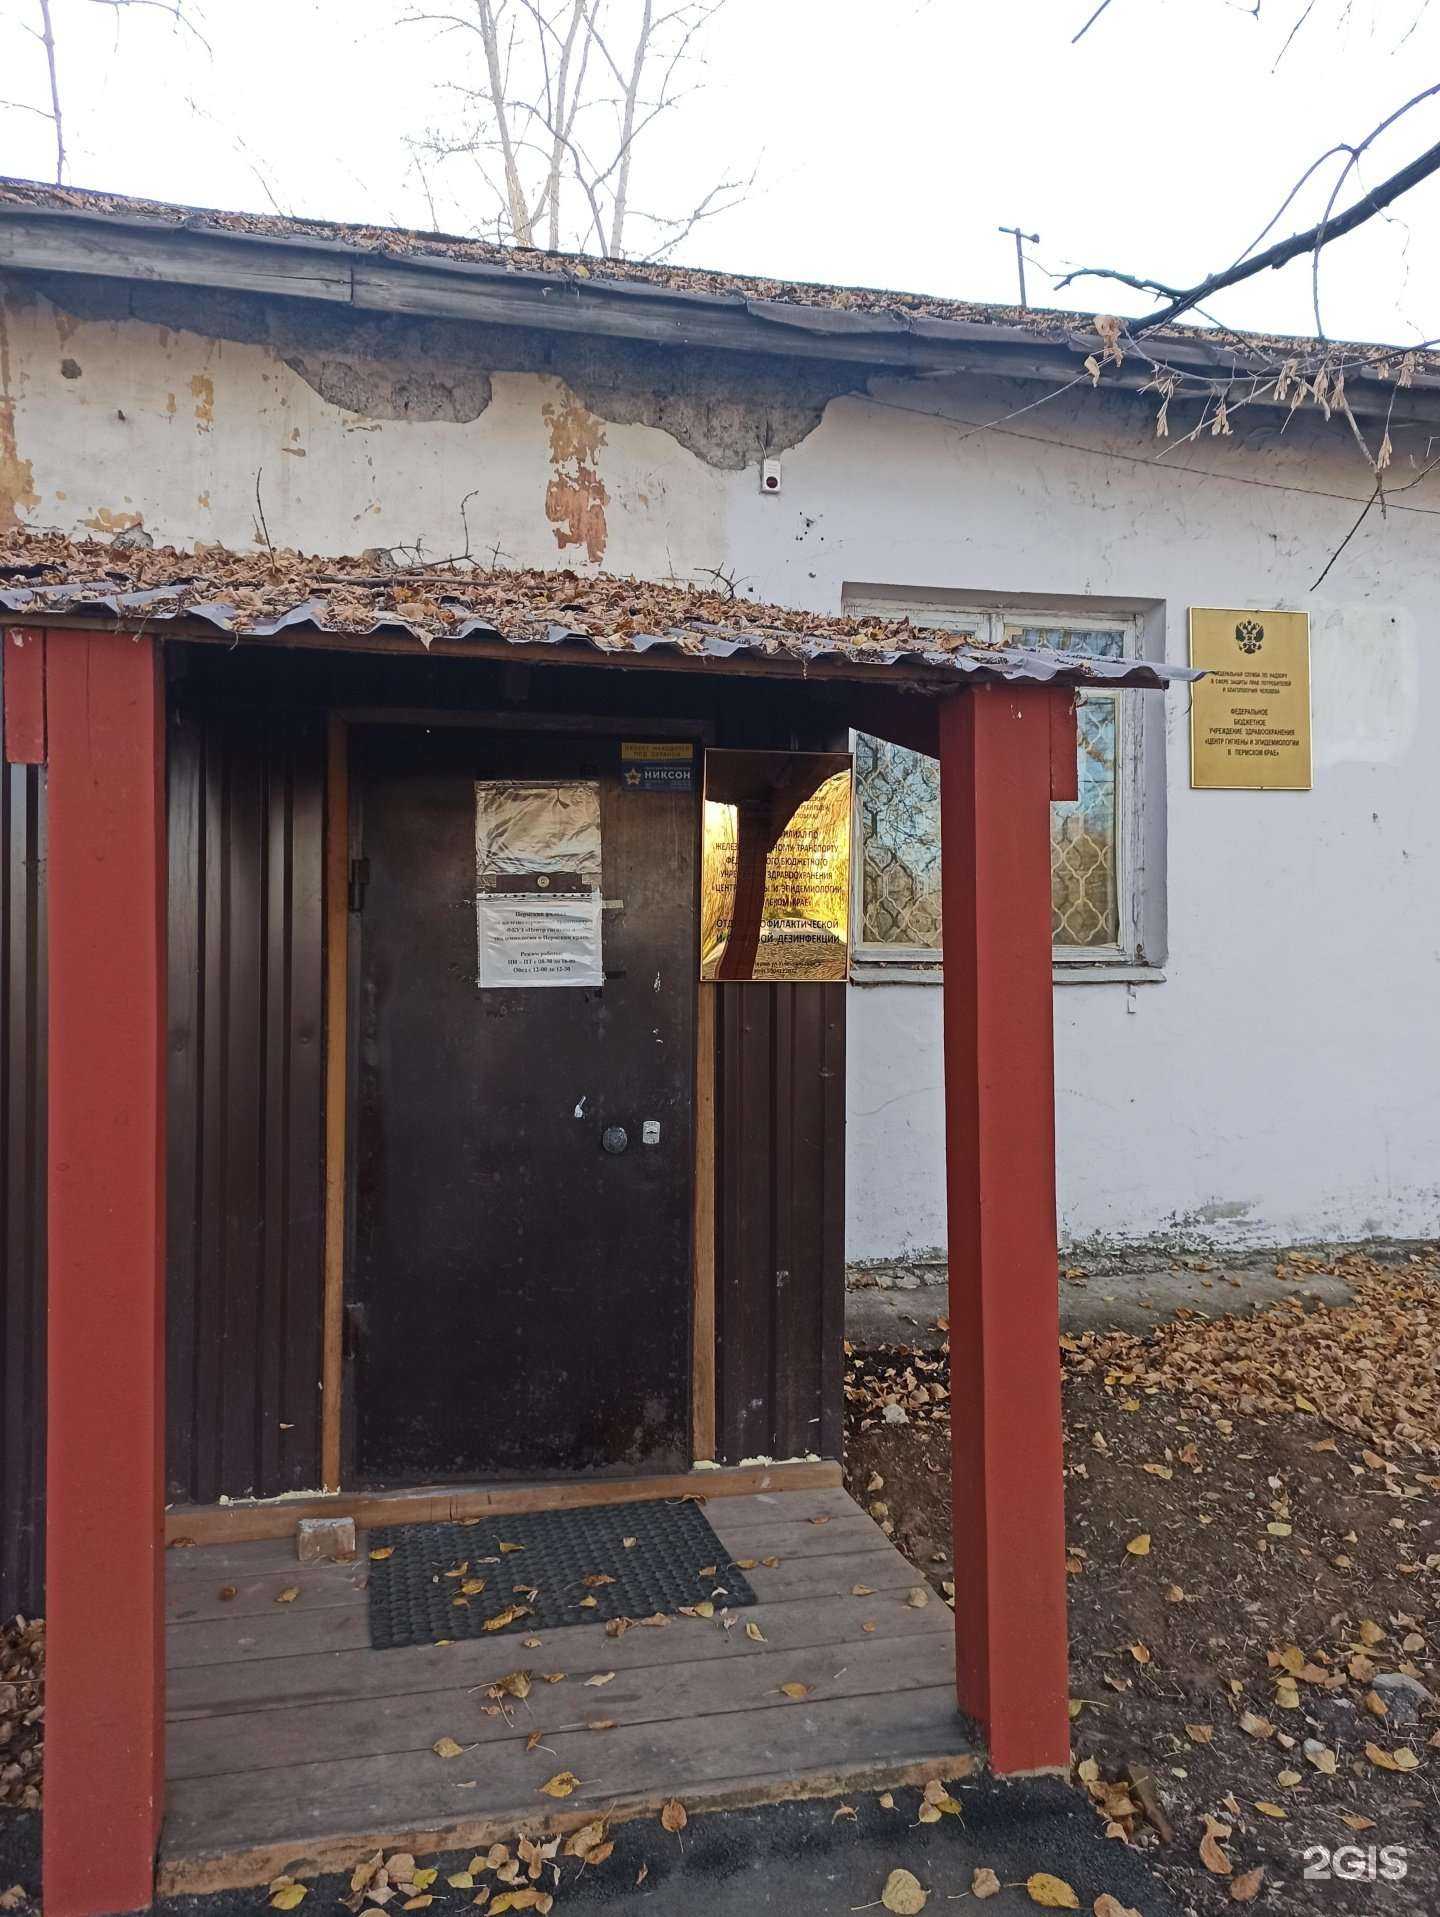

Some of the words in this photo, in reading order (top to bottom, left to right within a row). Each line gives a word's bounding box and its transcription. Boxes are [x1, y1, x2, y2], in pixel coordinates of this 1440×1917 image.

[1230, 708, 1268, 716] ФЕДЕРАЛЬНОЕ
[1234, 718, 1266, 726] БЮДЖЕТНОЕ
[1245, 728, 1295, 736] ЗДРАВООХРАНЕНИЯ
[644, 770, 691, 779] НИКСОН
[797, 844, 839, 853] ТРАНСПОРТУ
[781, 857, 828, 866] БЮДЖЕТНОГО
[767, 870, 833, 880] ЗДРАВООХРАНЕНИЯ
[777, 934, 840, 944] ДЕЗИНФЕКЦИИ
